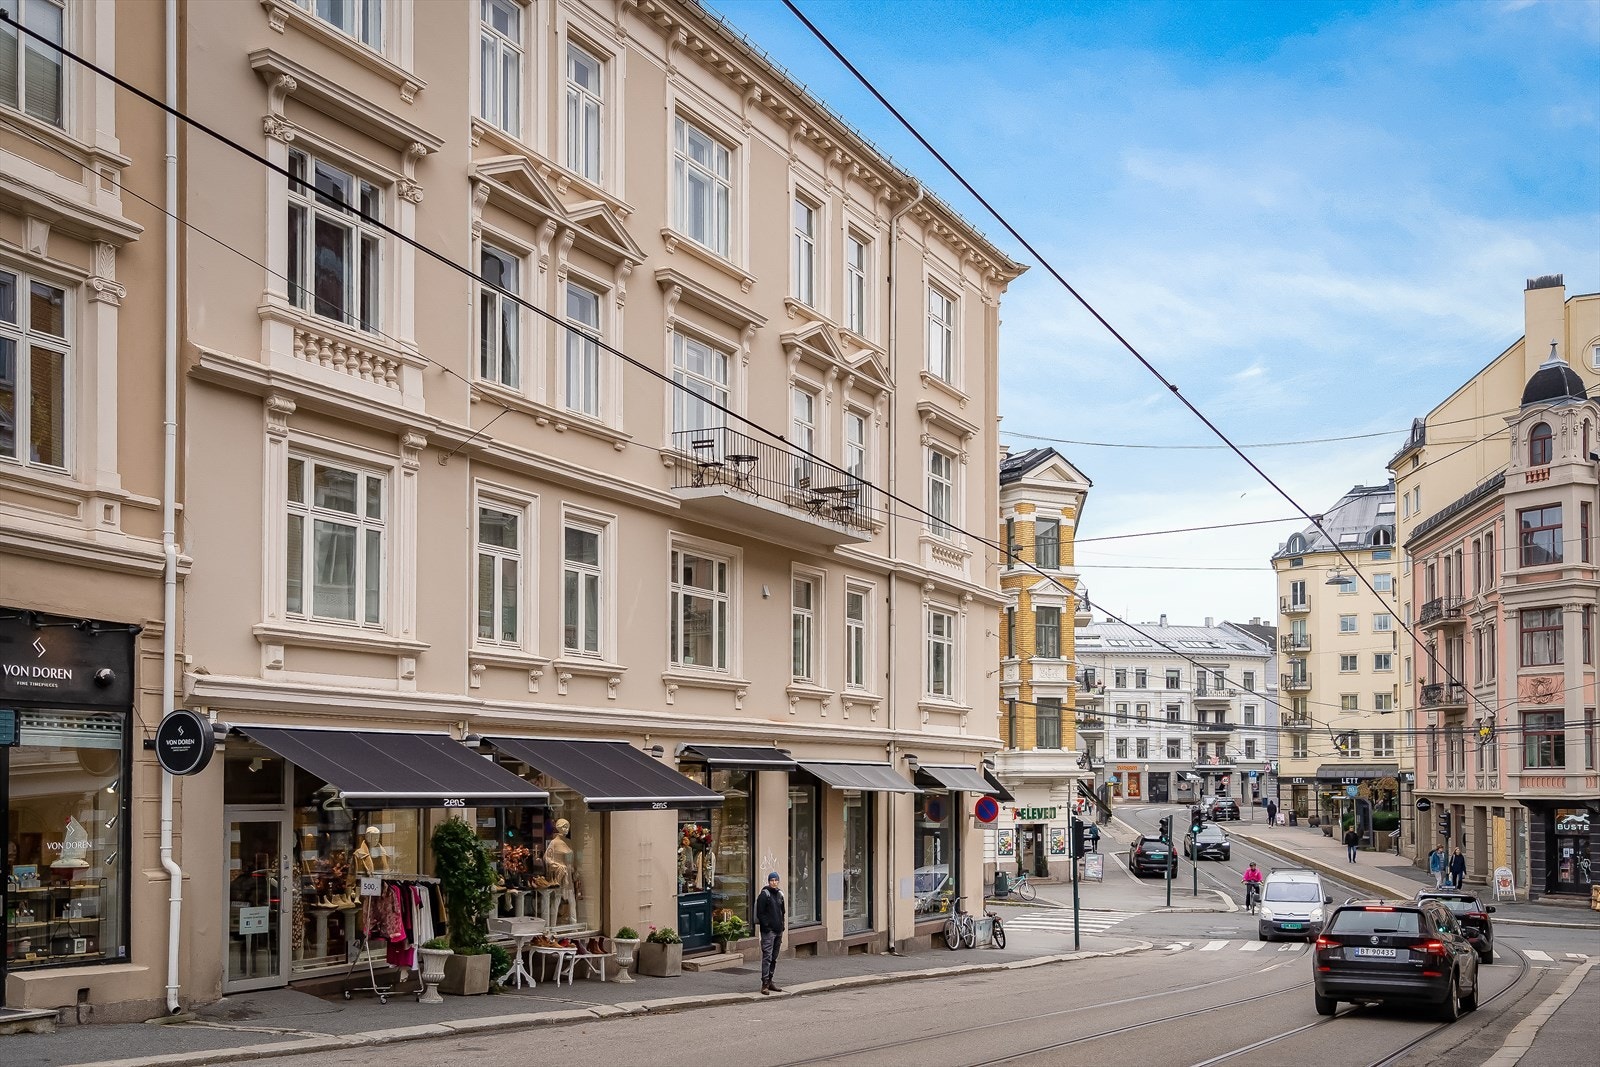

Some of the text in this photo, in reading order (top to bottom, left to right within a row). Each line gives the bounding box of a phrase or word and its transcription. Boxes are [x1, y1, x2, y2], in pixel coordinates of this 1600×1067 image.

[3, 664, 72, 680] VON DOREN
[1557, 823, 1590, 831] BUSTE
[66, 841, 91, 849] DOREN
[1371, 948, 1394, 956] 90435
